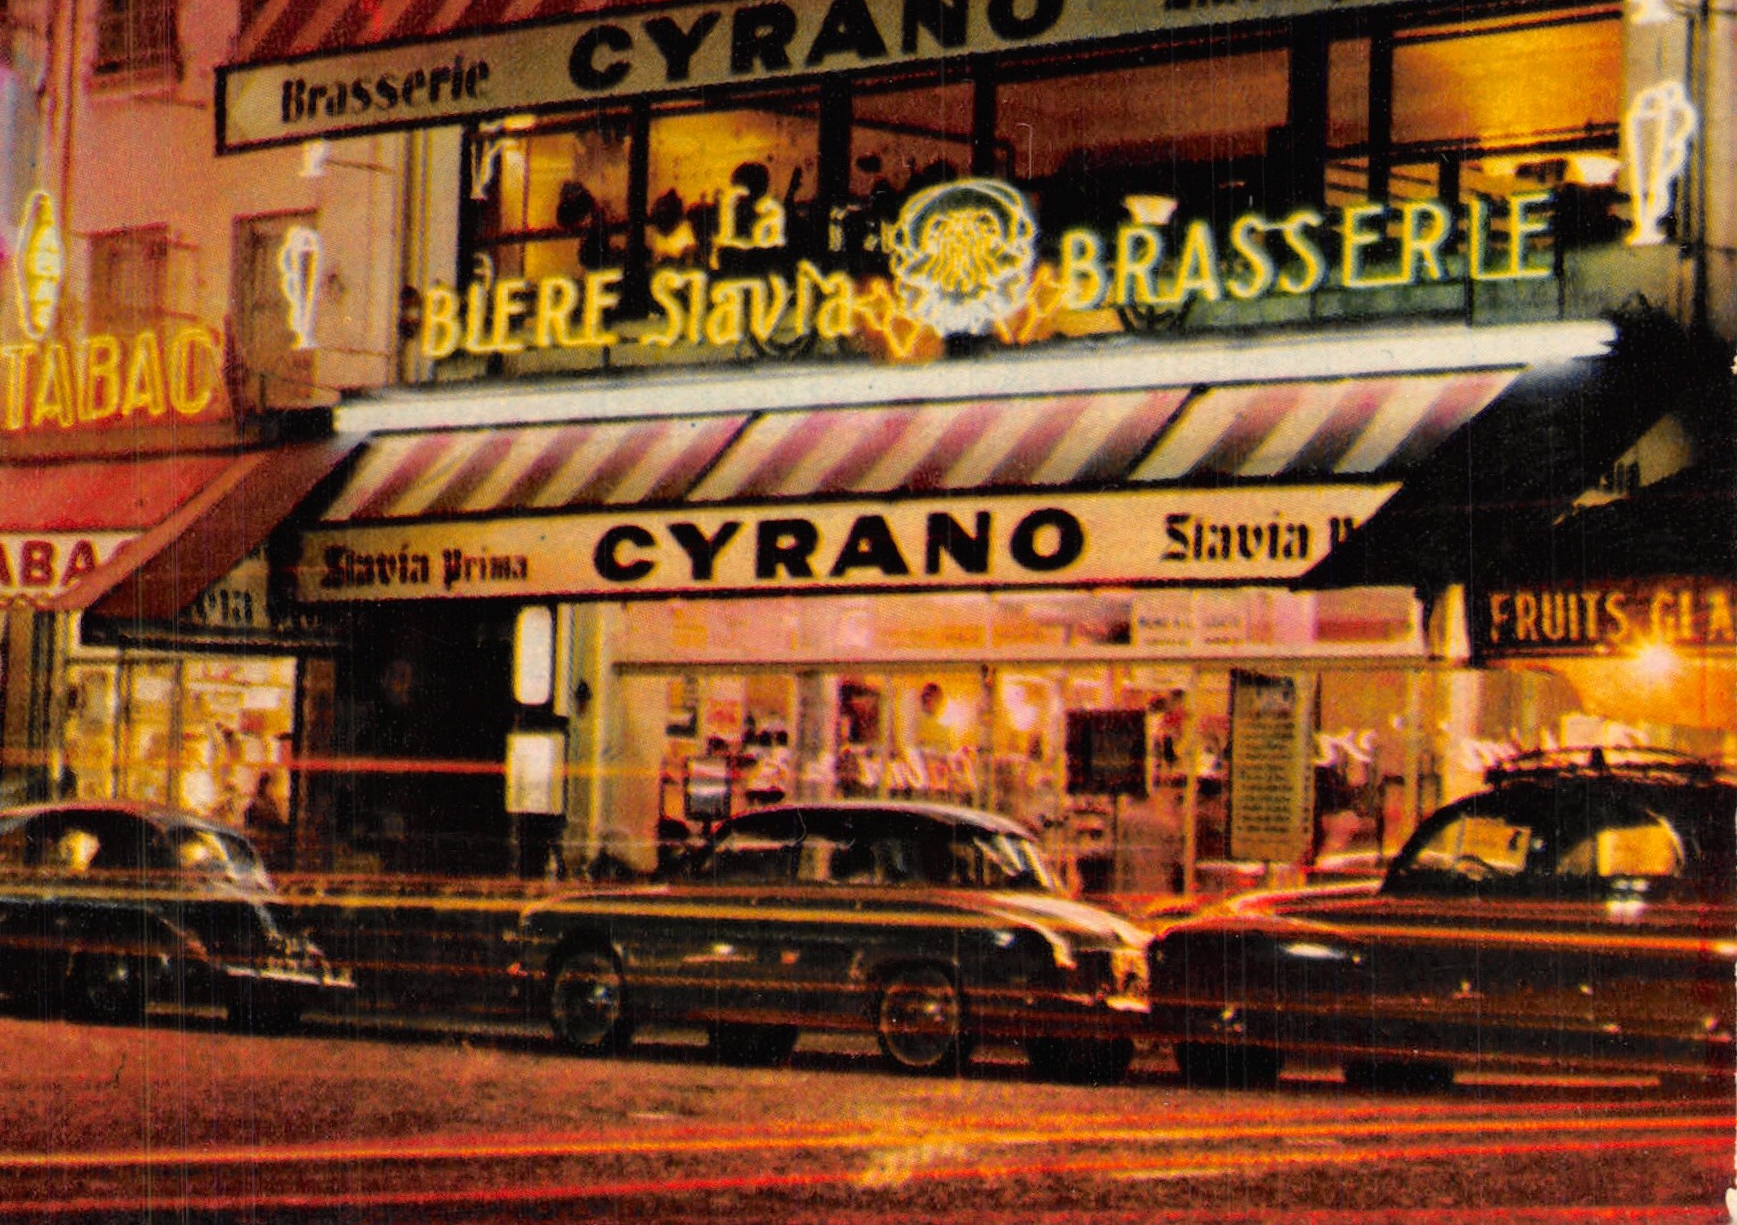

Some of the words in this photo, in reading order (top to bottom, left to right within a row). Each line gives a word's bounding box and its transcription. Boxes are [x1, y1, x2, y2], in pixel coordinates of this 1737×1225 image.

[280, 53, 491, 125] Brasserie
[710, 185, 786, 263] La
[640, 260, 857, 347] Slavia
[1062, 191, 1557, 313] BRASSERIE
[1, 326, 226, 430] TABAC
[320, 542, 430, 590] Slavia
[442, 544, 529, 592] Prima
[593, 508, 1087, 582] CYRANO
[1161, 510, 1310, 561] Slavia
[1489, 590, 1629, 643] FRUITS
